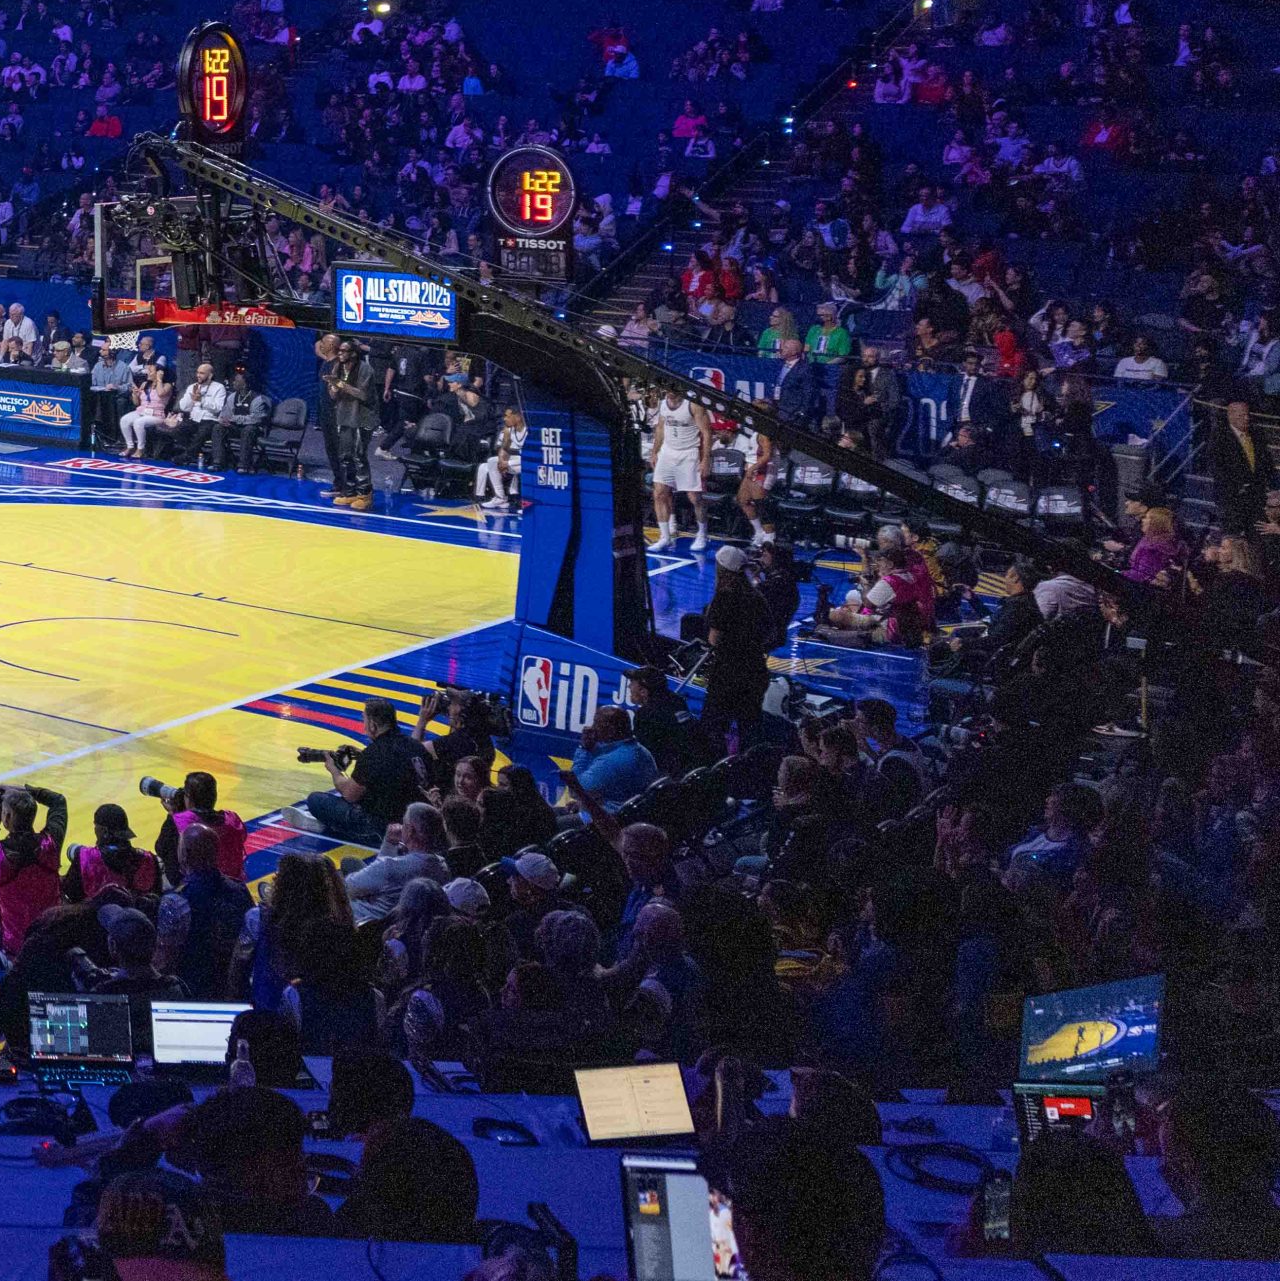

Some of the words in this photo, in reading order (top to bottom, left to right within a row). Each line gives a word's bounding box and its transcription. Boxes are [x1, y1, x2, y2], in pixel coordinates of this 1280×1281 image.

[205, 49, 229, 73] 1:22
[206, 76, 228, 120] 19
[522, 171, 561, 192] 1:22
[521, 194, 552, 221] 19
[516, 238, 566, 250] TISSOT
[421, 282, 451, 306] 2025
[541, 428, 562, 447] GET
[541, 447, 563, 466] THE
[49, 458, 224, 484] RUFFLES
[547, 469, 568, 490] App
